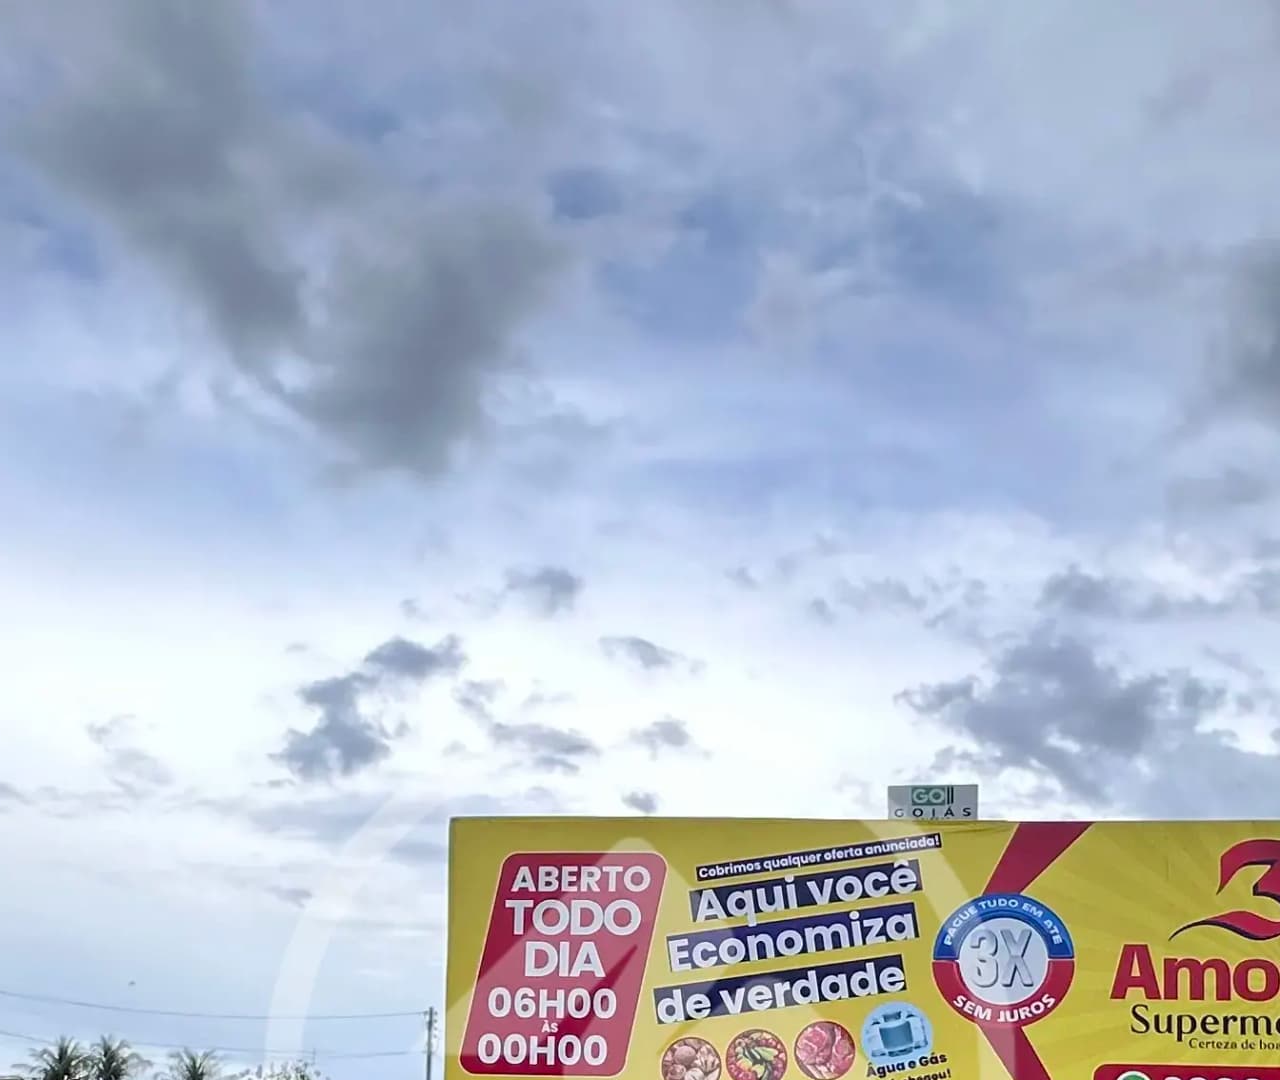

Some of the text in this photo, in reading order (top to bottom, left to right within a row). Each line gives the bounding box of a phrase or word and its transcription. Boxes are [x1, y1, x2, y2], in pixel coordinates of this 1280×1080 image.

[894, 806, 972, 818] GOIÁS
[698, 835, 940, 878] Cobrimos qualquer oferta anunciada!
[511, 865, 651, 892] ABERTO
[696, 859, 917, 927] Aqui você
[505, 899, 642, 936] TODO
[944, 905, 979, 946] PAGUE
[978, 898, 1019, 910] TUDO
[1022, 902, 1043, 918] EM
[668, 911, 915, 972] Economiza
[970, 928, 1034, 988] 3X
[524, 941, 606, 978] DIA
[487, 986, 617, 1019] 06H00
[657, 962, 905, 1024] de verdade
[953, 993, 1057, 1023] SEM JUROS
[541, 1019, 559, 1033] ÀS
[1188, 1037, 1238, 1050] Certeza
[1241, 1039, 1256, 1050] de
[477, 1033, 608, 1065] 00H00
[866, 1062, 906, 1079] Água
[919, 1052, 948, 1067] Gás
